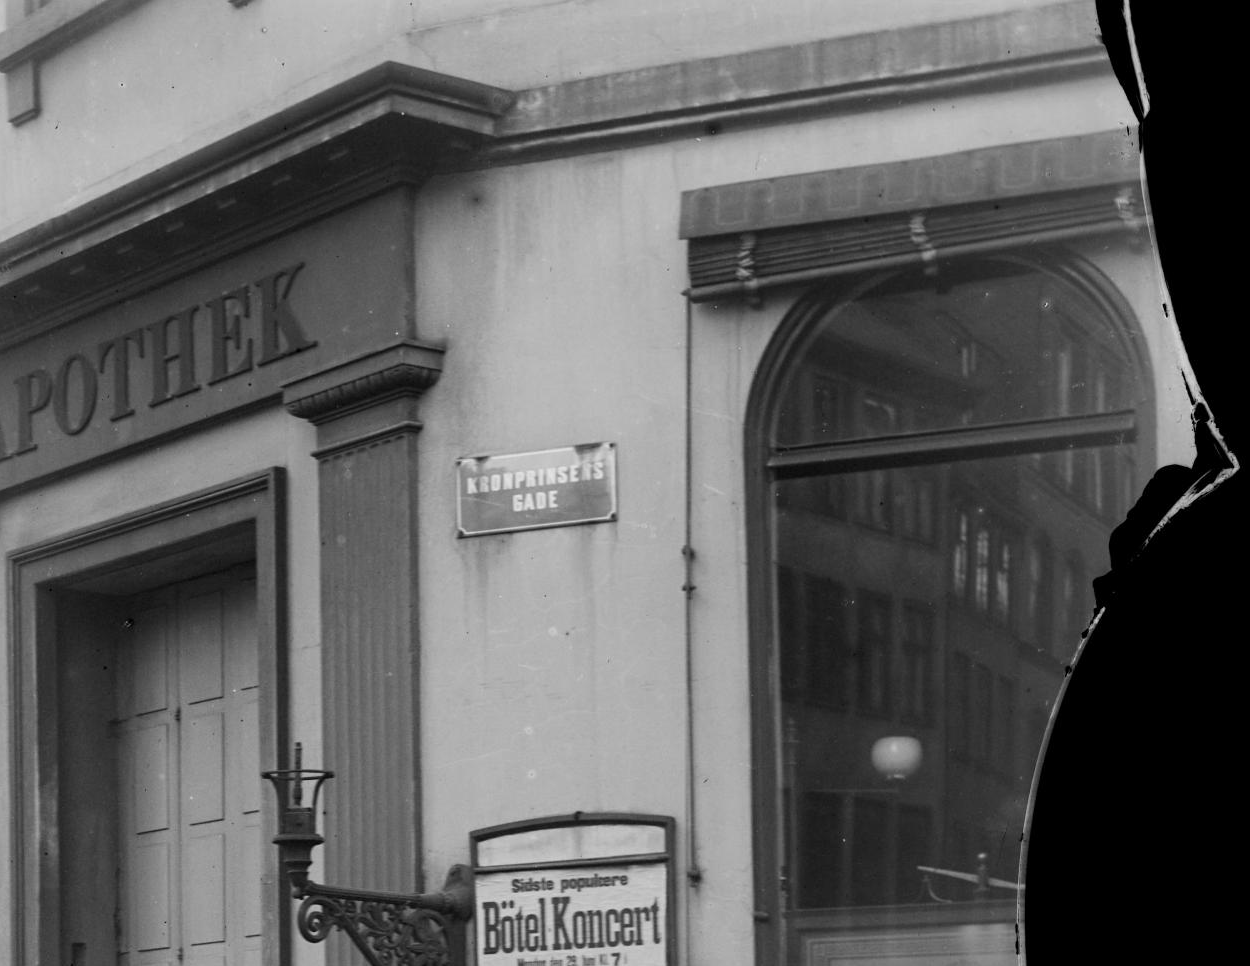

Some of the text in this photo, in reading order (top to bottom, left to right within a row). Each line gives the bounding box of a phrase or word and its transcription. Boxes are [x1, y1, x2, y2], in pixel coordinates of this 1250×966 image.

[512, 490, 558, 512] GADE
[512, 876, 554, 893] Sidste
[482, 896, 661, 955] Bötel Koncert
